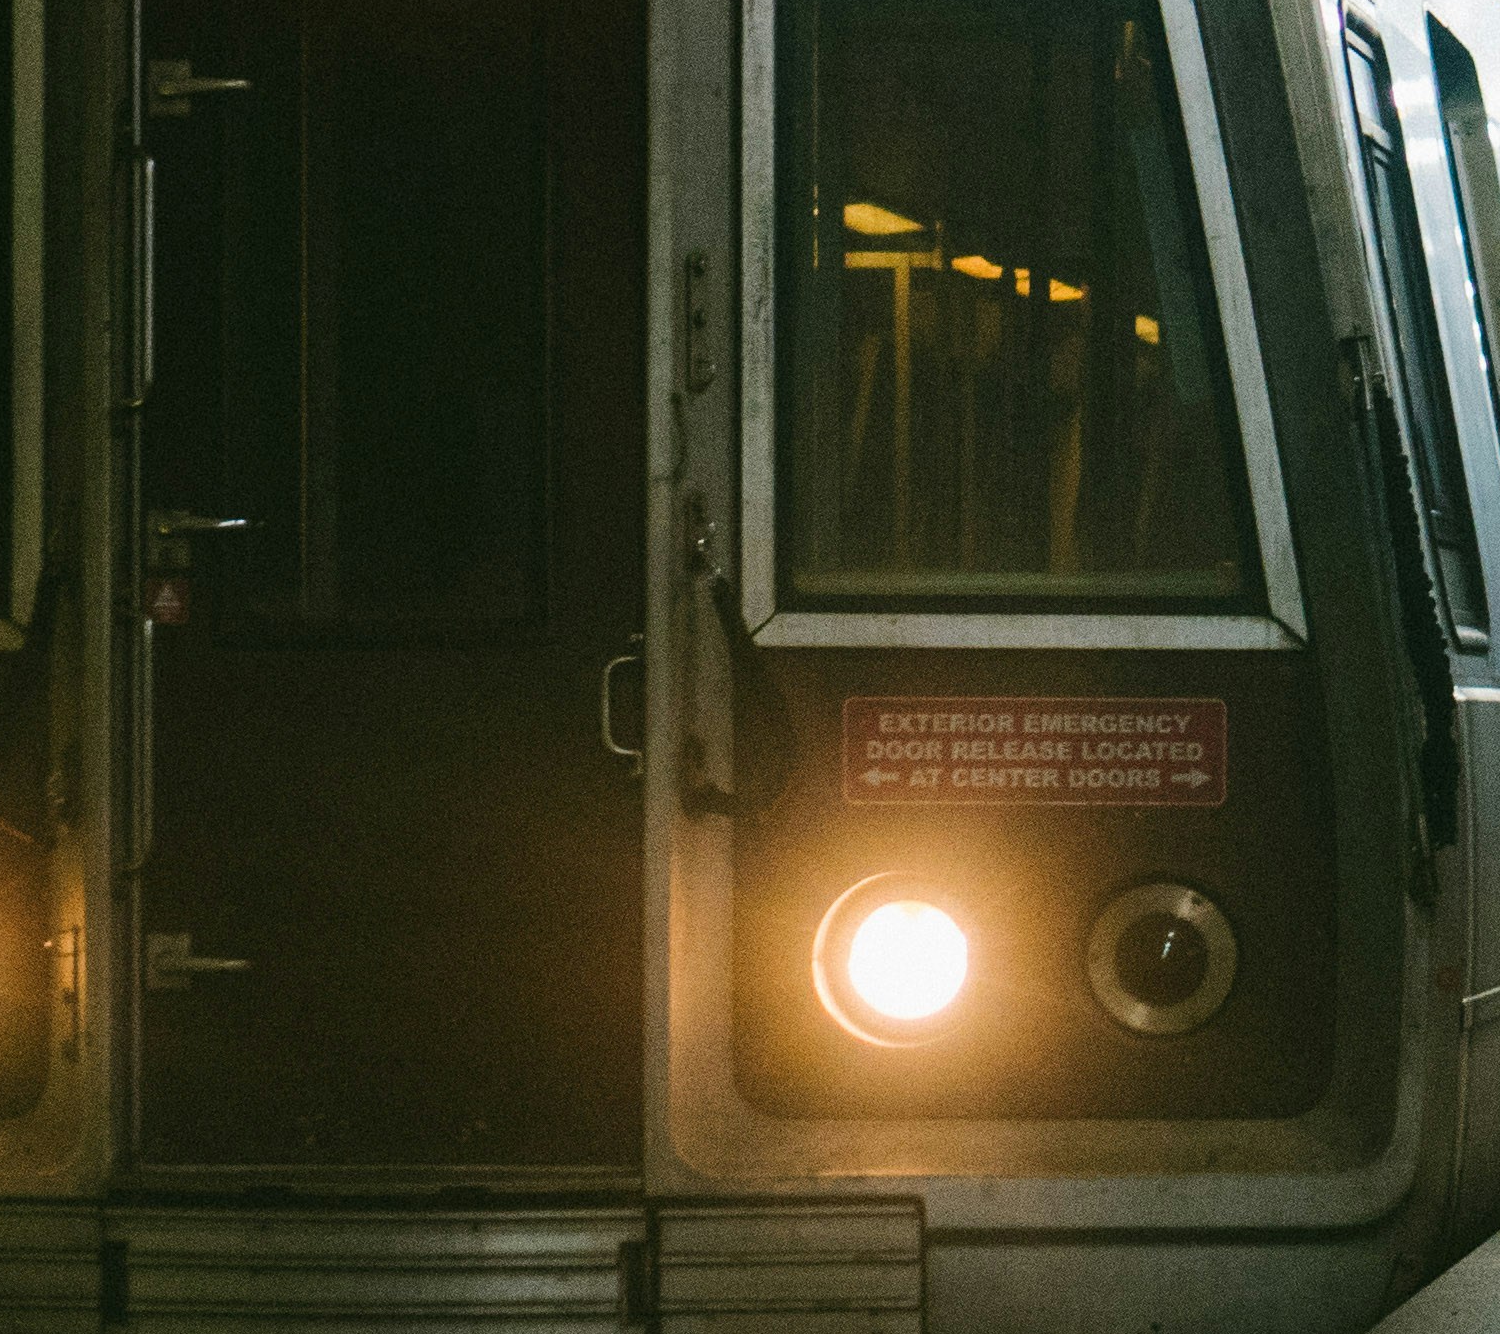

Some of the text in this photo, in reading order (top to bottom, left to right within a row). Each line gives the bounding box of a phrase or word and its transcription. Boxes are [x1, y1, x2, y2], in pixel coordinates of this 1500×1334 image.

[879, 713, 1192, 734] EXTERIOR EMERGENCY
[866, 740, 1203, 762] DOOR RELEASE LOCATED
[909, 768, 1161, 788] AT CENTER DOORS
